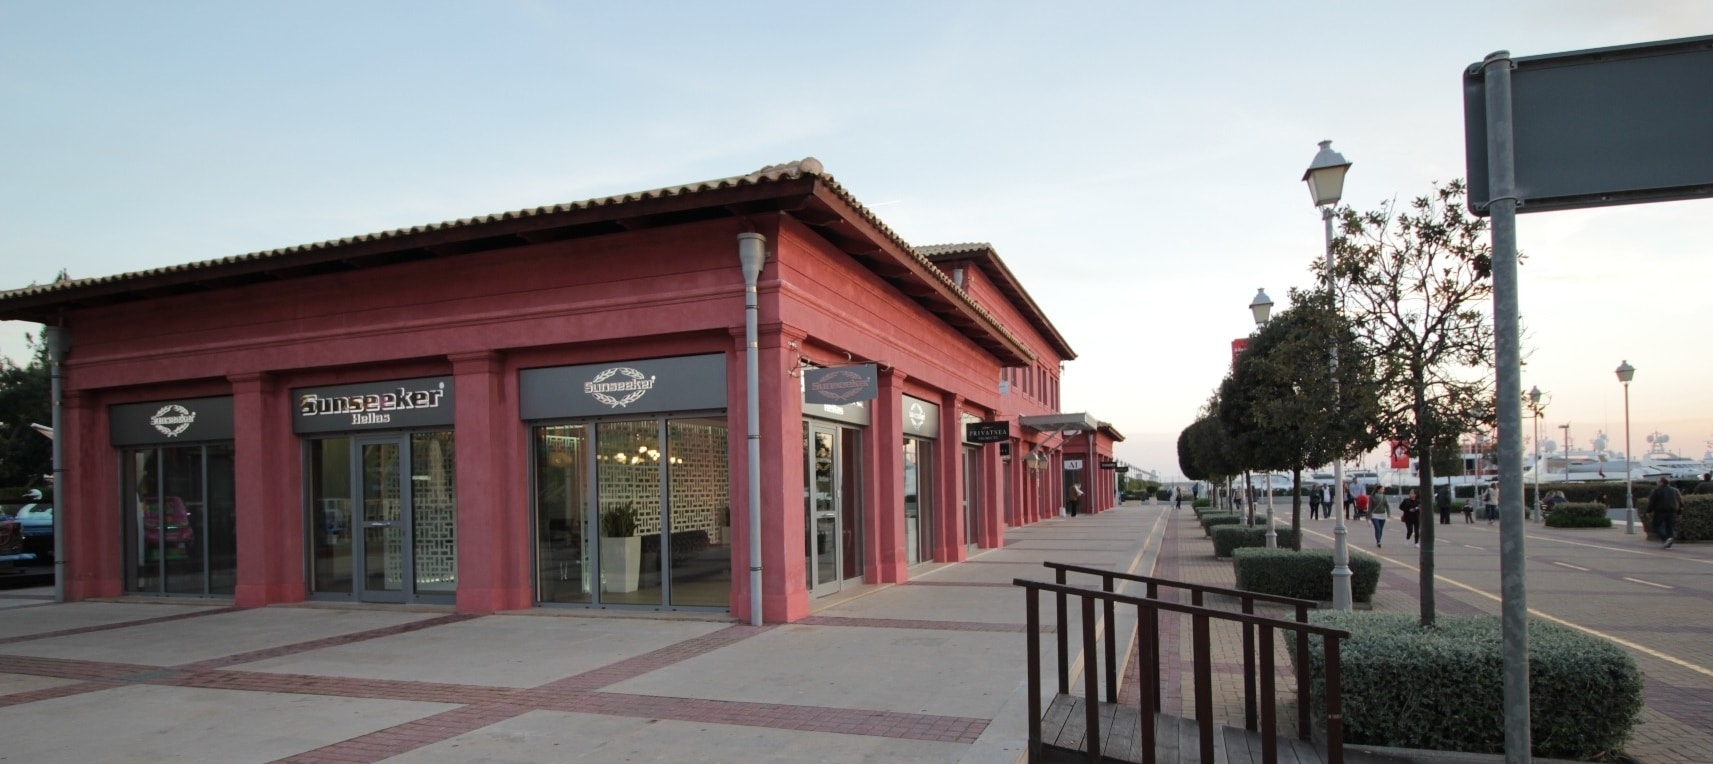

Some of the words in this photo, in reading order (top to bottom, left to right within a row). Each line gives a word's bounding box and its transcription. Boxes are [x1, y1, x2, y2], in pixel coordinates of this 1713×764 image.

[584, 378, 655, 393] Sunseeker
[301, 385, 445, 416] Sunseeker
[352, 413, 390, 425] Hellas
[969, 429, 1007, 437] PRIVATSEA
